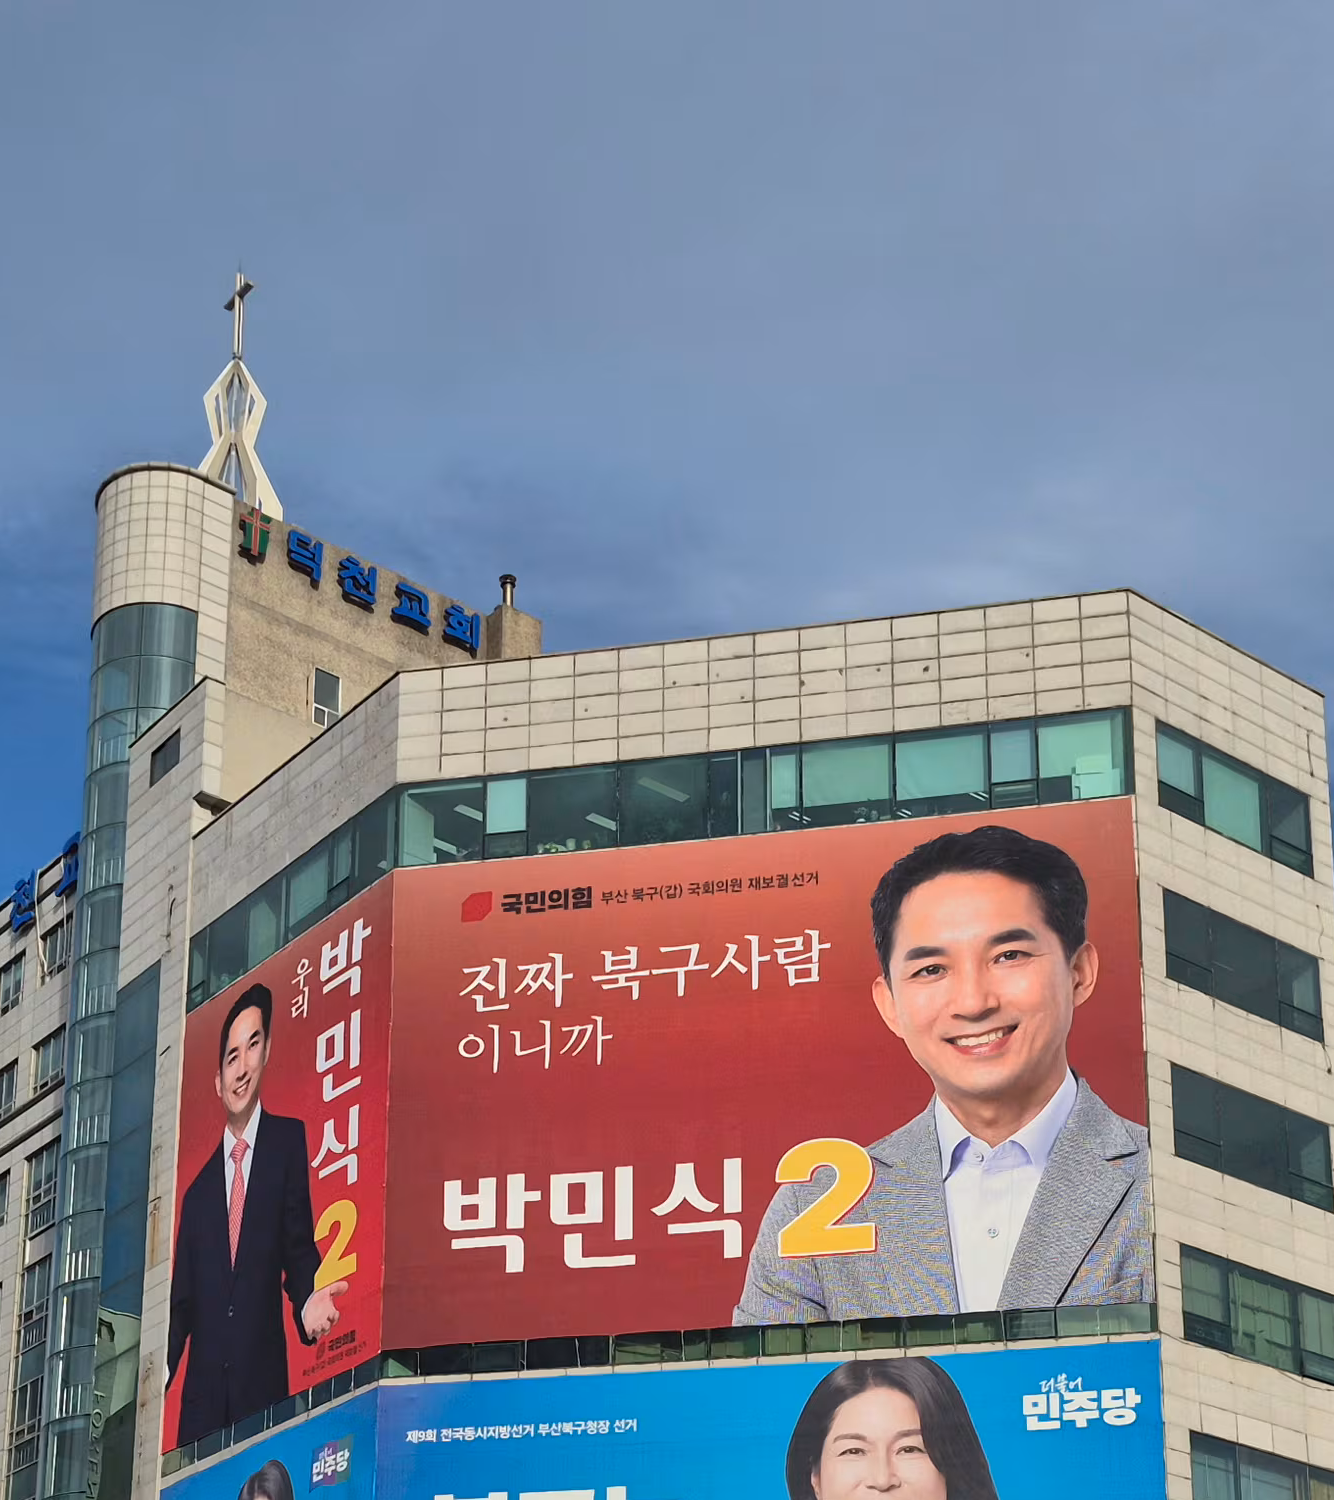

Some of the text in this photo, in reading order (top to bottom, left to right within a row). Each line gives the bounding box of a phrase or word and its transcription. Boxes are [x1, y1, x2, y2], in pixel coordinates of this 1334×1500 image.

[286, 528, 481, 650] 덕천교회
[501, 885, 593, 915] 국민의힘
[600, 887, 629, 906] 부산
[631, 883, 683, 903] 북구(갑)
[687, 877, 743, 897] 국회의원
[290, 958, 313, 1020] 우리
[459, 928, 832, 1013] 진짜 북구사람
[310, 917, 373, 1188] 박민식
[457, 1015, 614, 1074] 이니까
[442, 1137, 879, 1275] 박민식 2
[313, 1199, 359, 1292] 2
[1022, 1387, 1142, 1431] 민주당
[1039, 1372, 1083, 1393] 더불어
[405, 1418, 638, 1444] 제9회 전국동시지방선거 부산북구청장 선거
